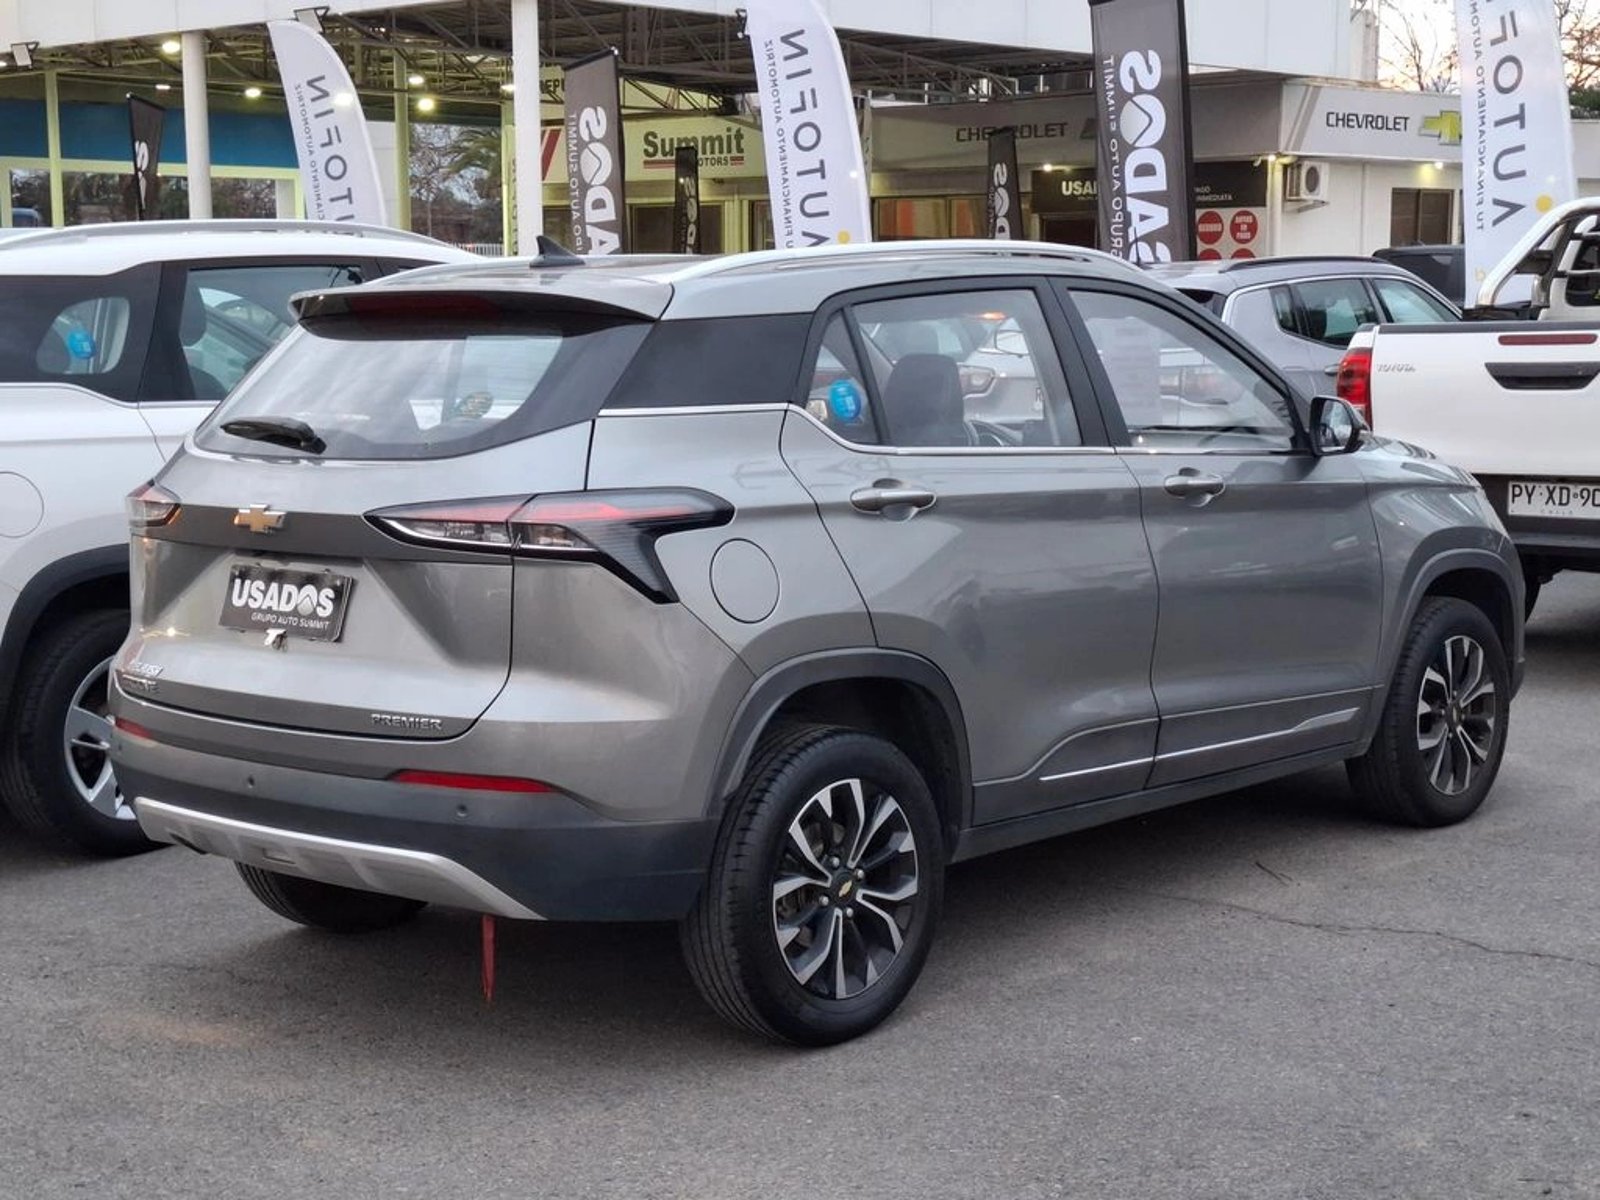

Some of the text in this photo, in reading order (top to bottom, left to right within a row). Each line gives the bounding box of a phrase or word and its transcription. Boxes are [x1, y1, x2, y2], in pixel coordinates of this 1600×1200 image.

[1326, 111, 1410, 132] CHEVROLET
[643, 127, 744, 158] Summit
[697, 156, 729, 167] OTORS
[1061, 181, 1097, 196] USA
[231, 578, 336, 618] USADOS
[251, 612, 331, 630] GRUPO AUTO SUMMIT
[370, 713, 442, 730] PREMIER
